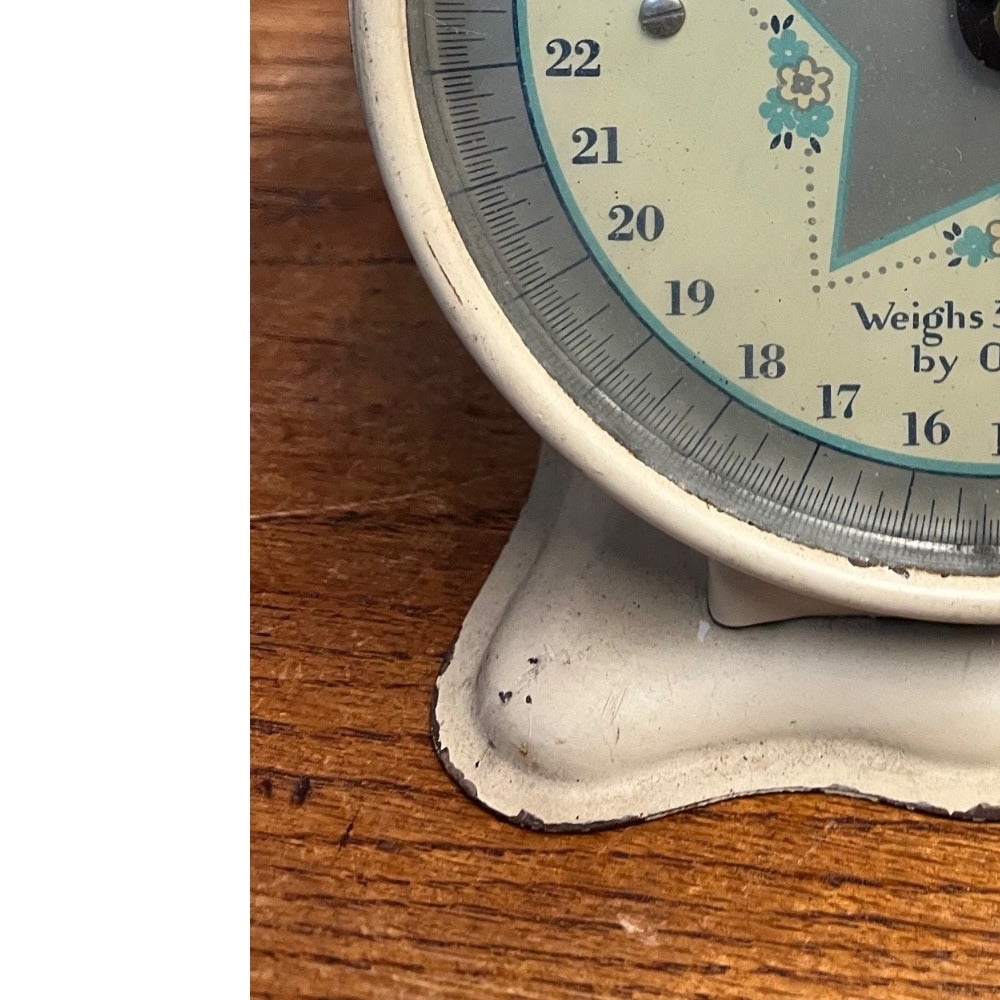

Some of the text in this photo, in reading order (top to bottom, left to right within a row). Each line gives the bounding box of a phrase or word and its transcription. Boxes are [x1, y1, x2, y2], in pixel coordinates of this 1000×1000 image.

[546, 39, 600, 77] 22
[572, 127, 622, 164] 21
[608, 205, 664, 241] 20
[665, 280, 714, 316] 19
[851, 301, 983, 347] Weighs
[739, 344, 785, 378] 18
[911, 345, 958, 383] by
[817, 384, 861, 419] 17
[902, 410, 950, 446] 16
